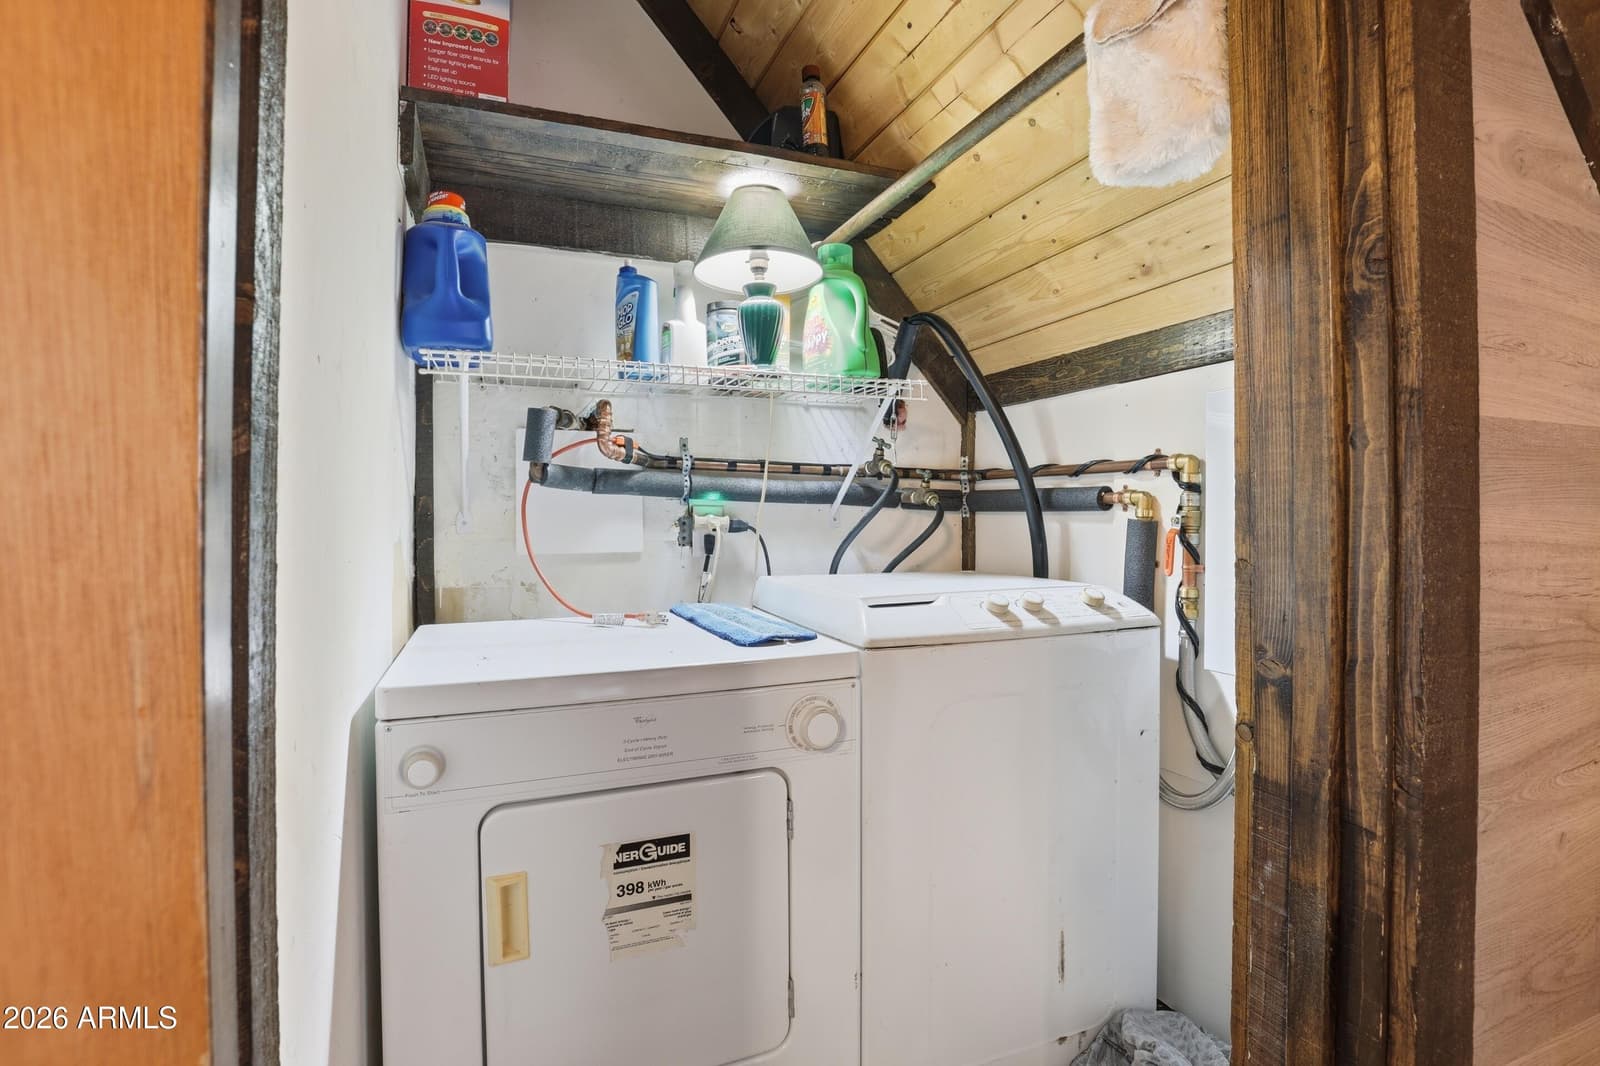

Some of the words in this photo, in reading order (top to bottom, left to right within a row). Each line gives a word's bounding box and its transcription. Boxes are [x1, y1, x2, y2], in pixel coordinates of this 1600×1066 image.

[442, 41, 469, 50] Improved
[428, 47, 446, 56] Longer
[448, 58, 466, 68] lighting
[428, 64, 440, 72] Easy
[440, 75, 458, 84] lighting
[616, 880, 645, 898] 398
[647, 879, 667, 890] kWh
